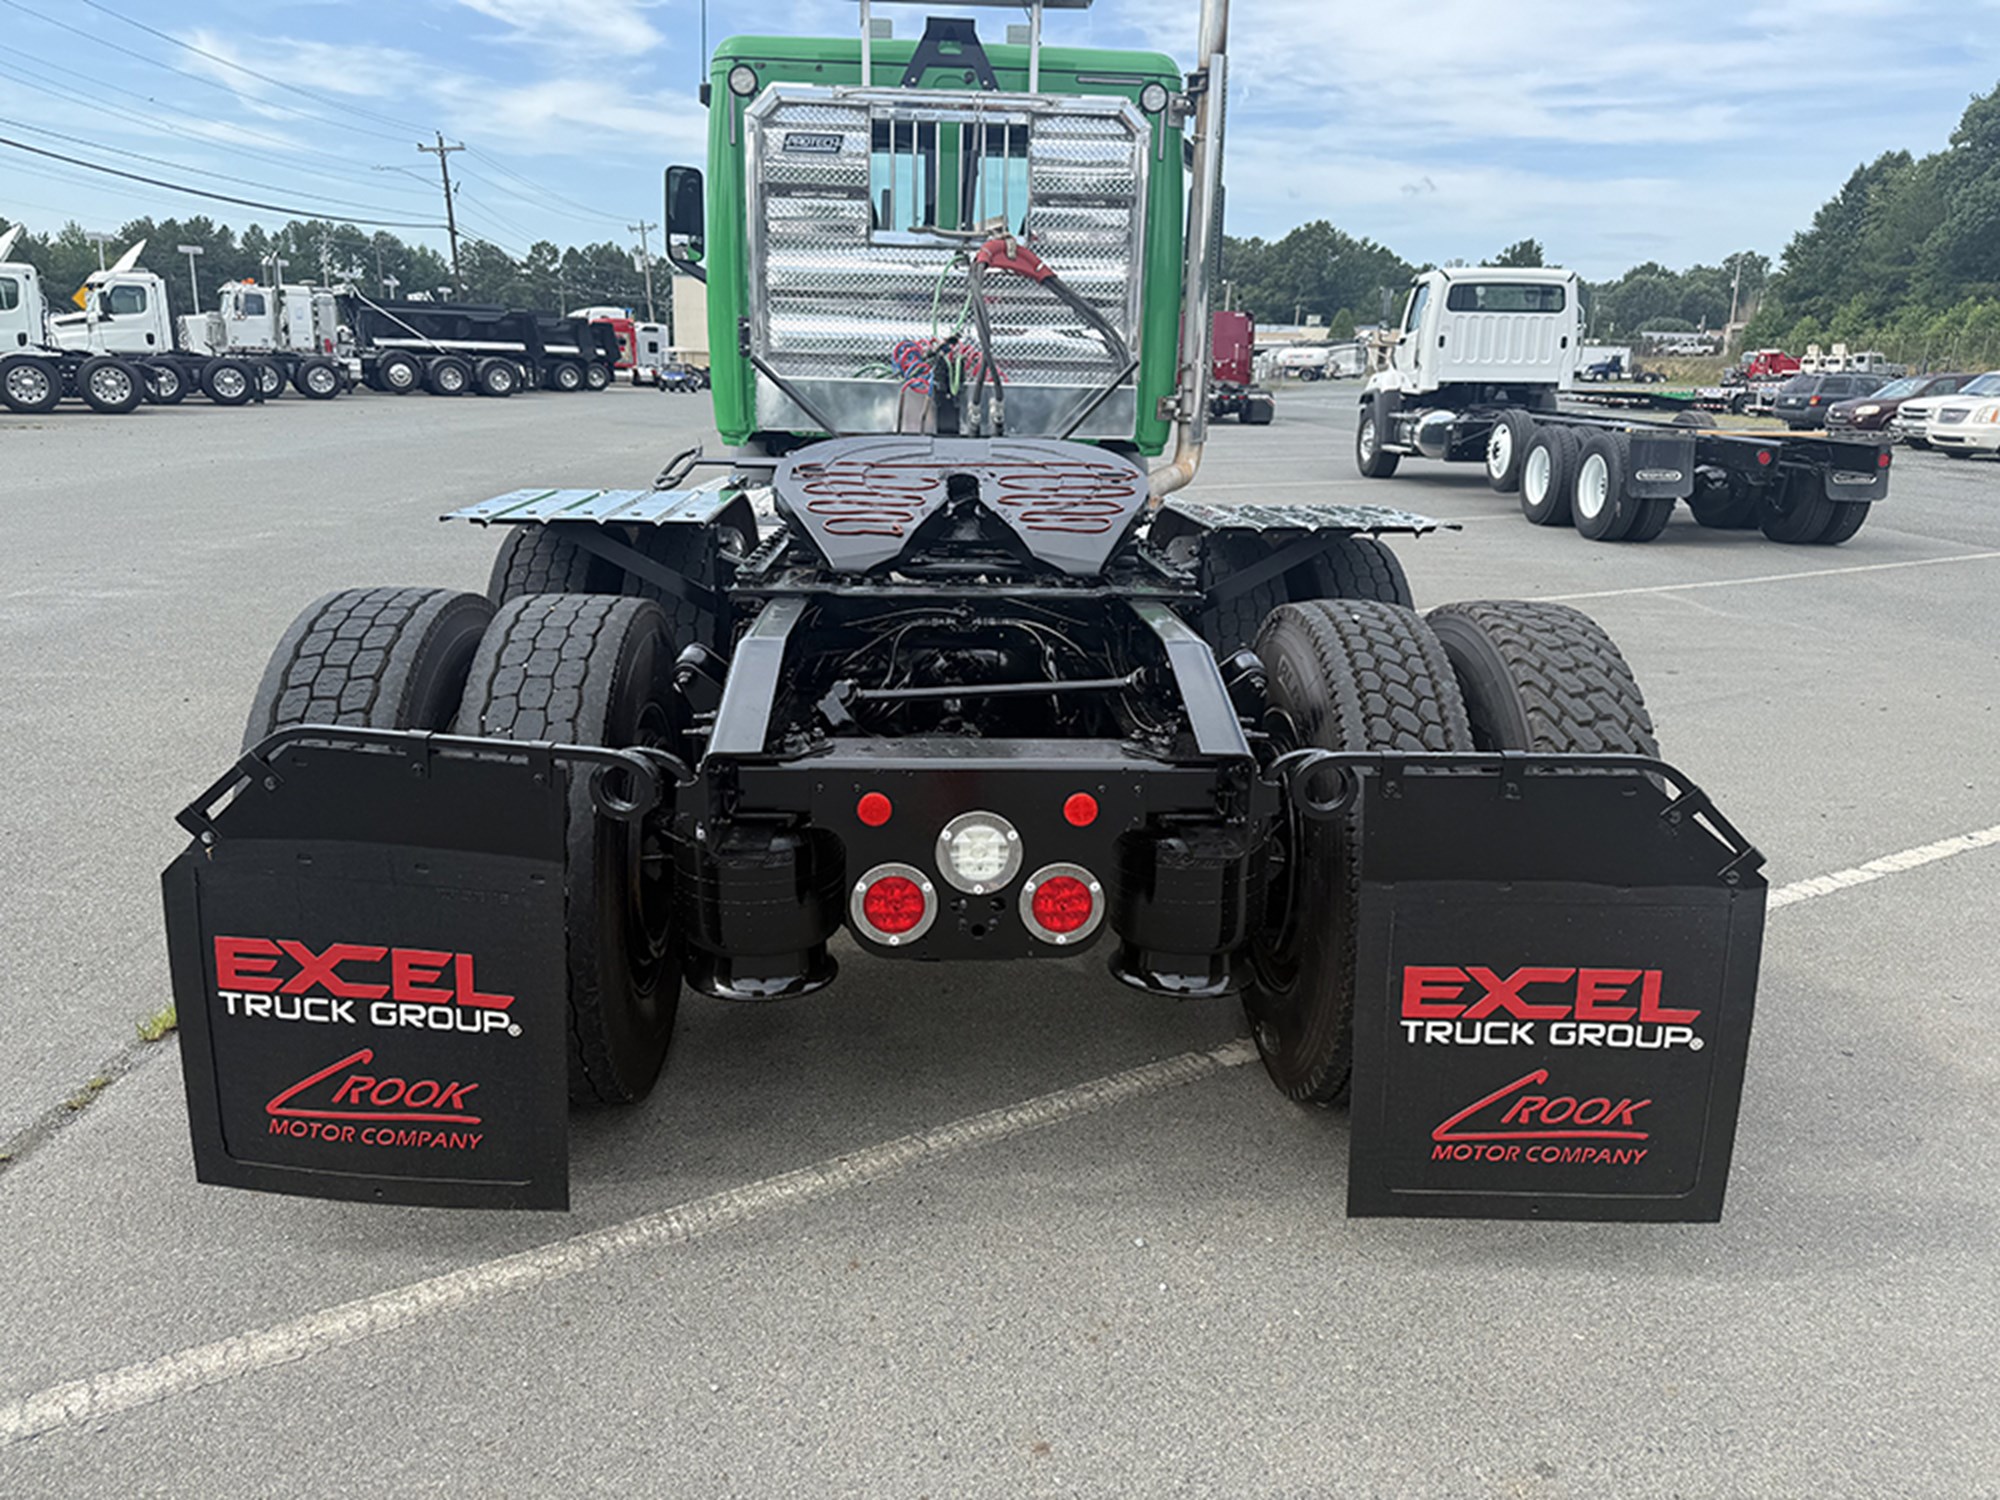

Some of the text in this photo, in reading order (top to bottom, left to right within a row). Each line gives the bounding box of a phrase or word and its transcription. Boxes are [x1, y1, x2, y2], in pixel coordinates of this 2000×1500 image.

[213, 936, 515, 1010] EXCEL
[217, 991, 356, 1024] TRUCK
[1401, 966, 1701, 1024] EXCEL
[1399, 1020, 1535, 1046] TRUCK
[268, 1118, 484, 1149] MOTOR COMPANY
[1430, 1144, 1649, 1165] MOTOR COMPANY
